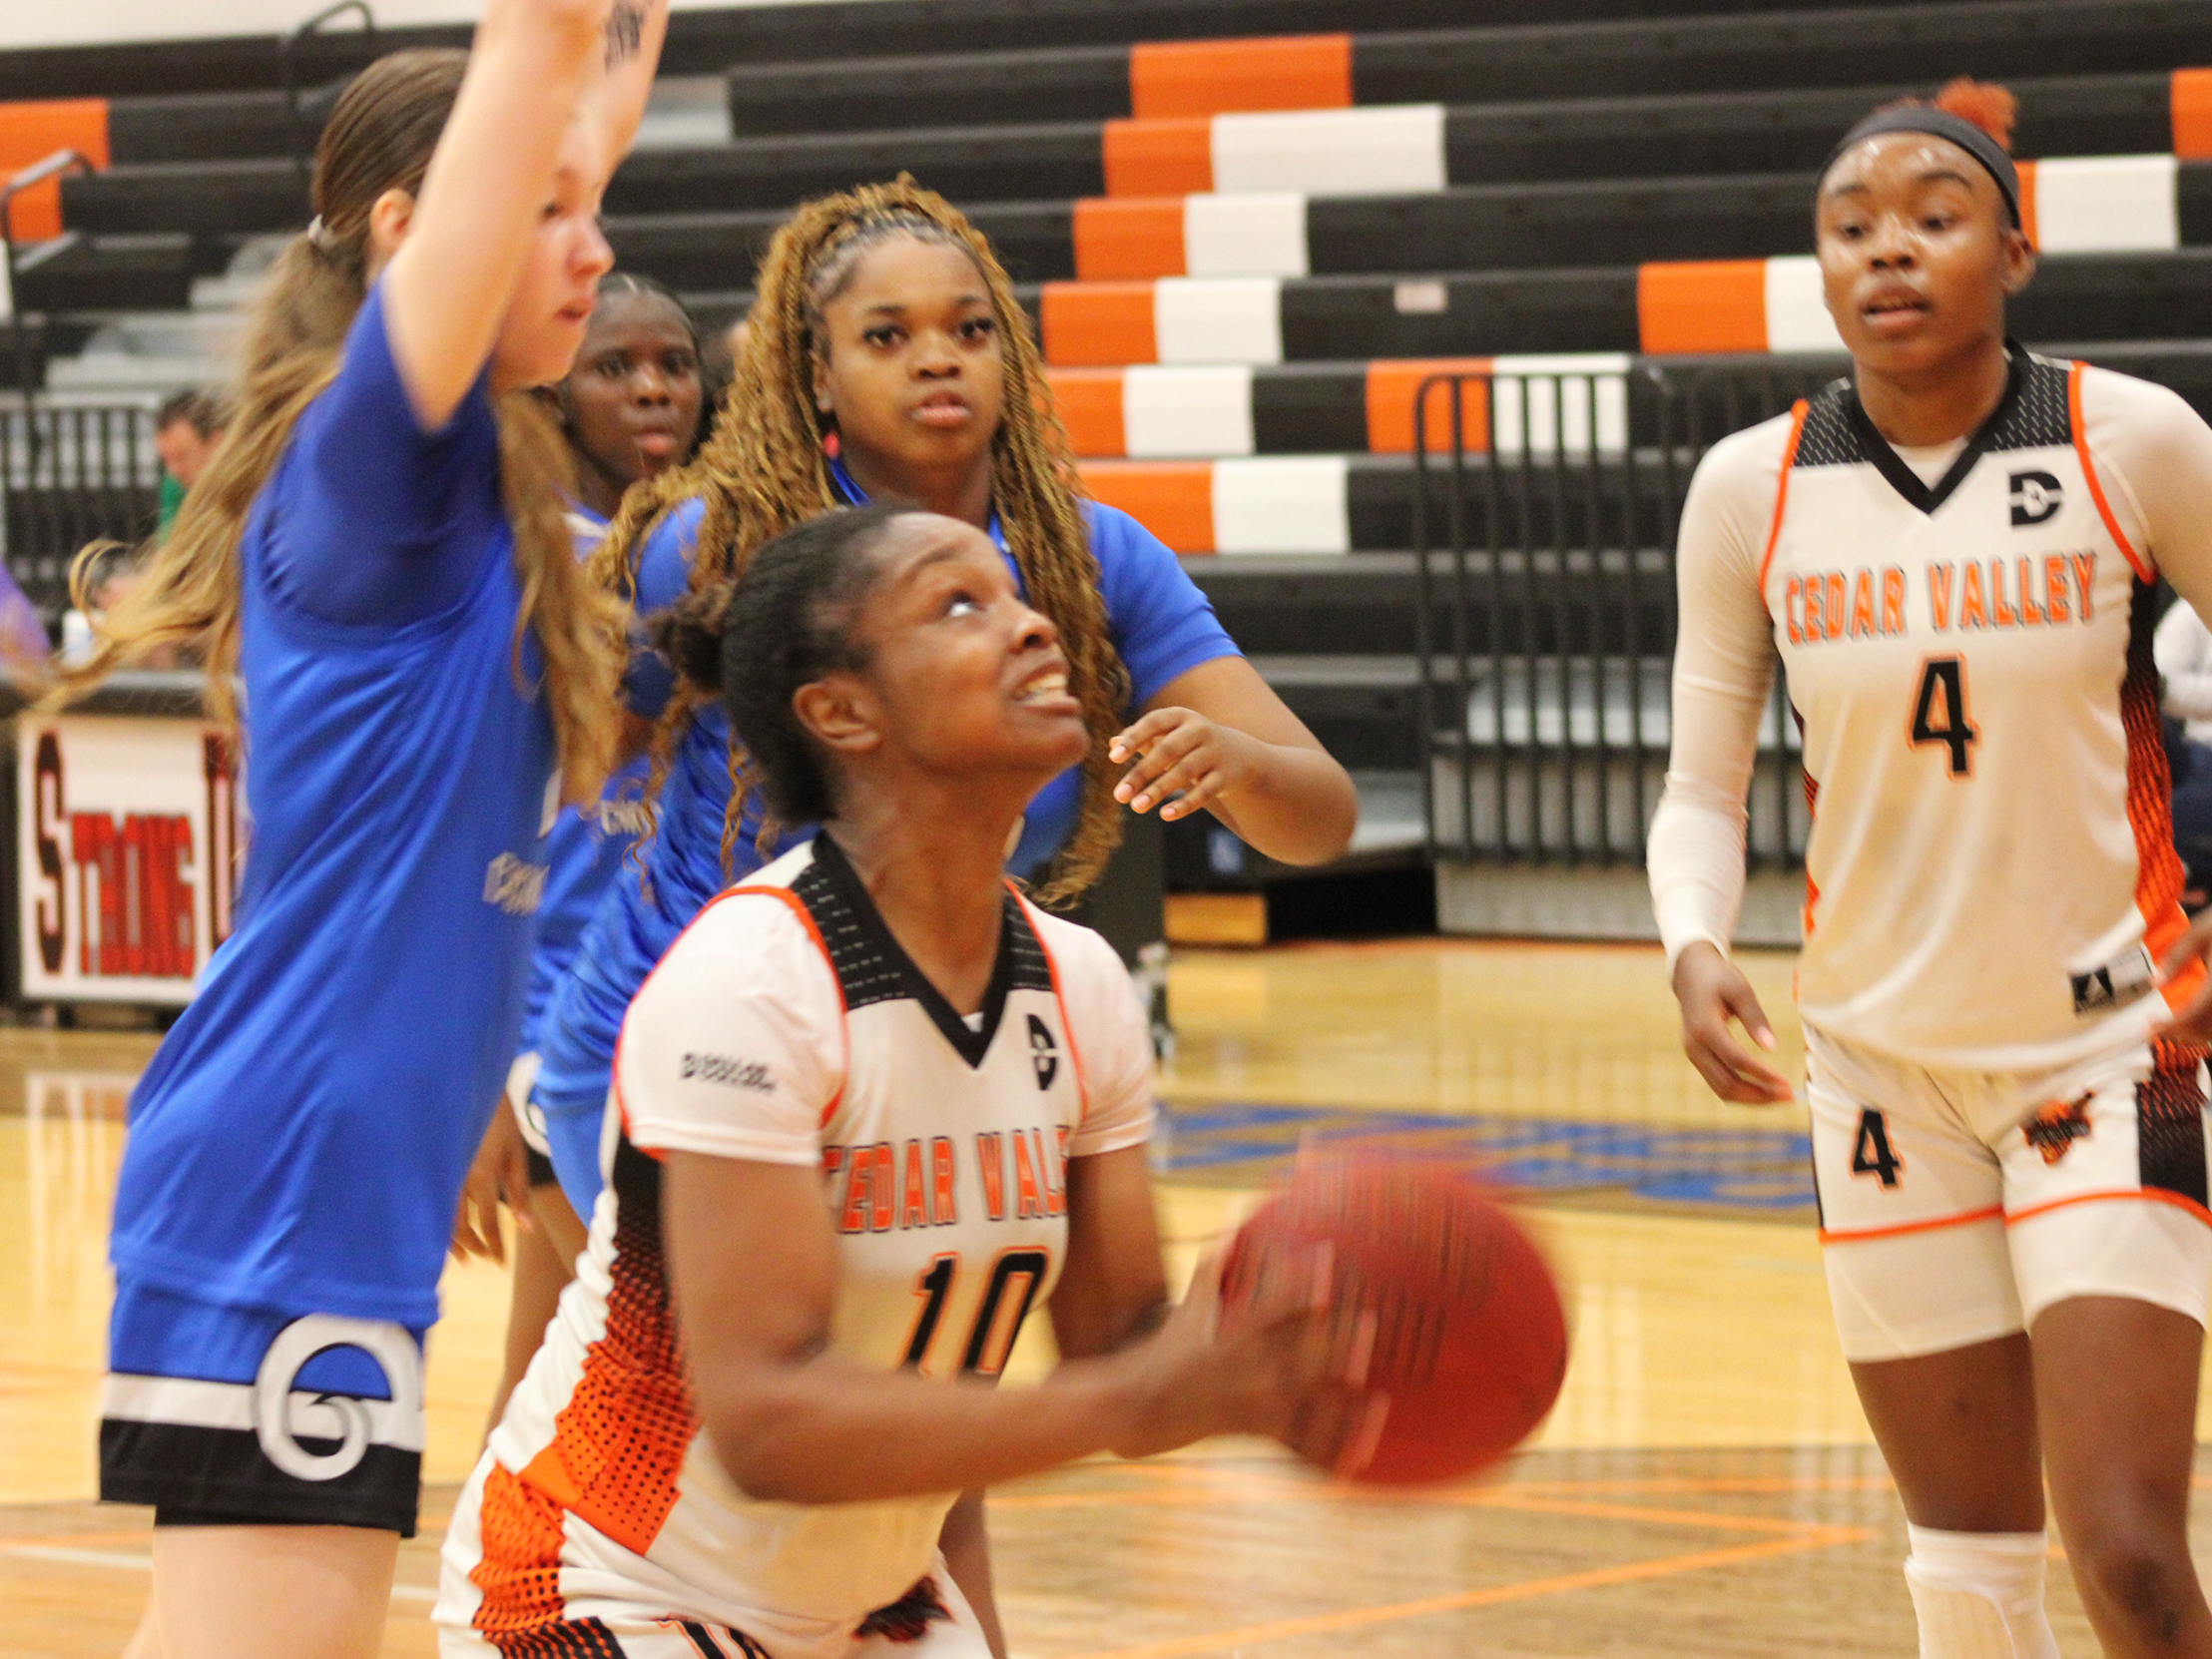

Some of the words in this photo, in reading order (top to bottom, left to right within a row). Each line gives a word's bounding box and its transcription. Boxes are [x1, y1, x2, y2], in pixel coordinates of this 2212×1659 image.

[1785, 563, 1906, 646] CEDAR
[1926, 549, 2096, 632] VALLEY
[1905, 651, 1980, 783] 4
[1849, 1105, 1906, 1195] 4
[898, 1245, 1051, 1380] 10
